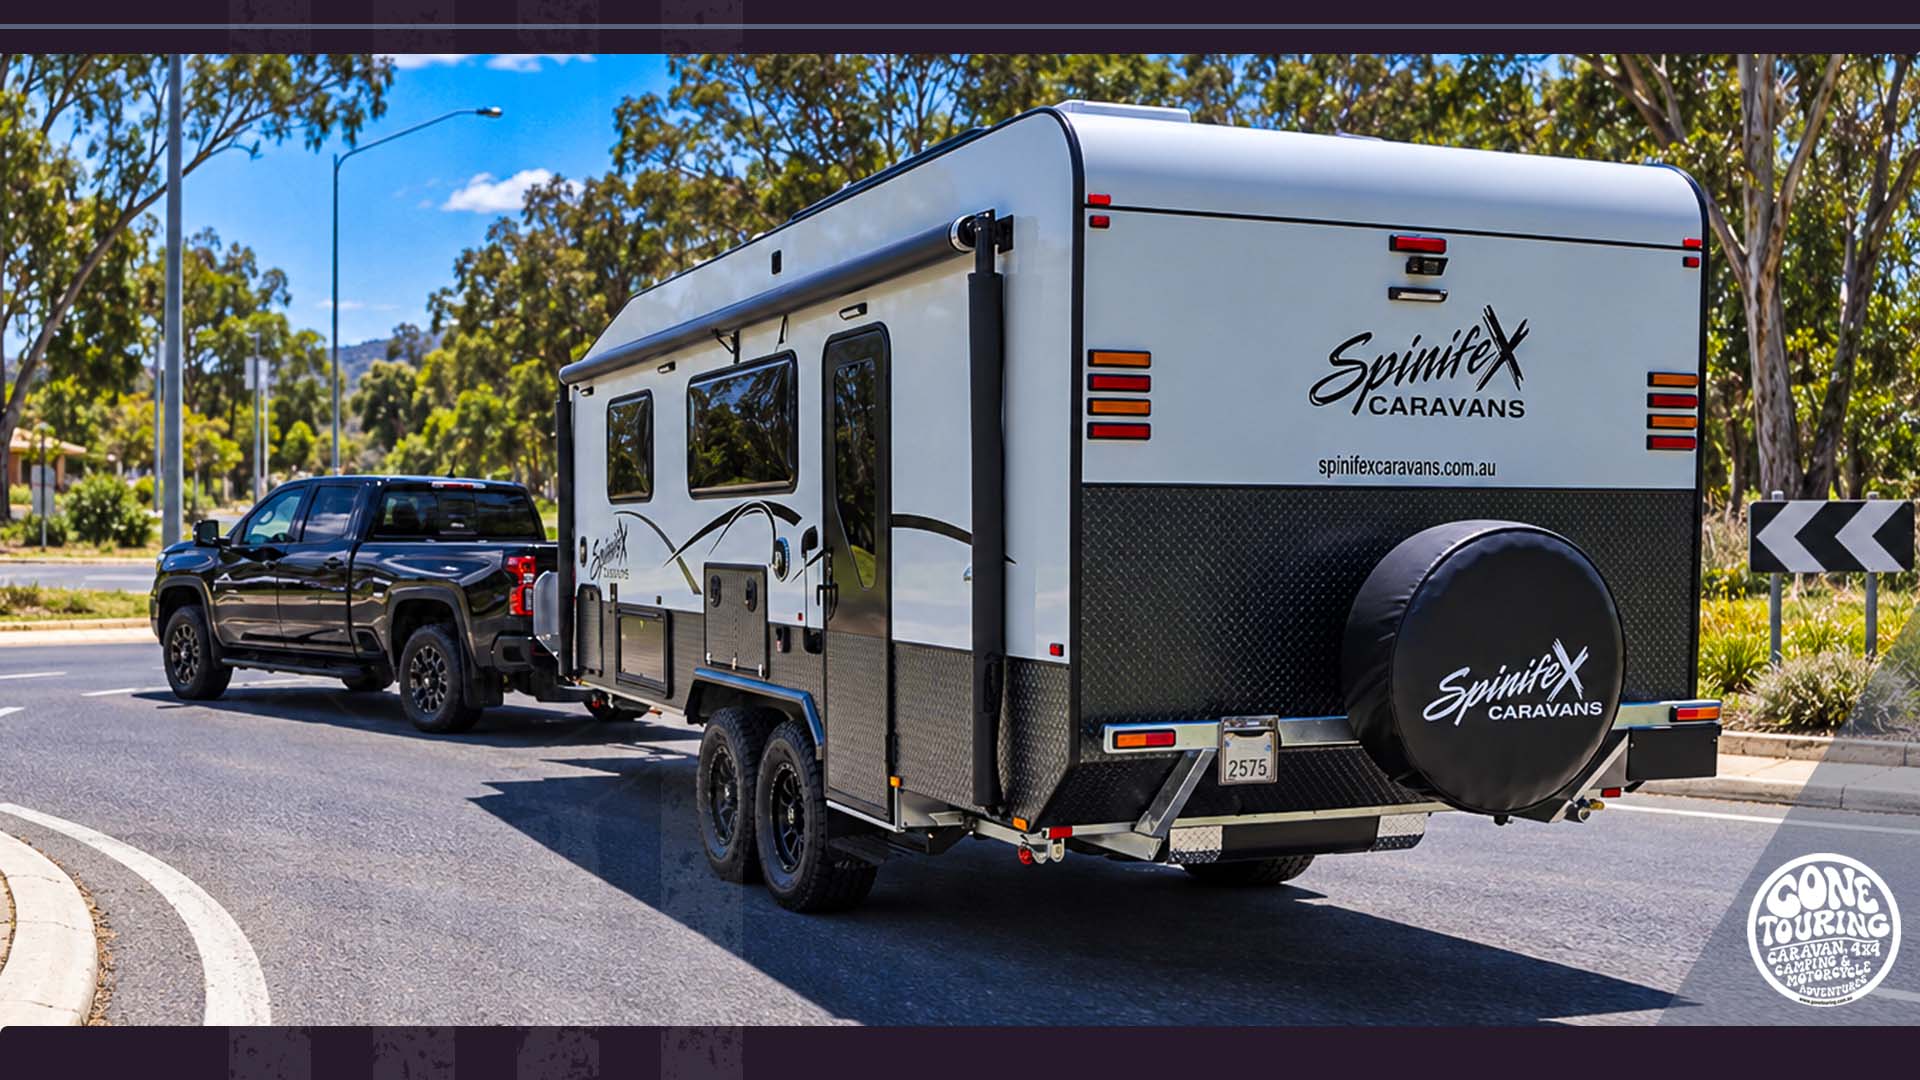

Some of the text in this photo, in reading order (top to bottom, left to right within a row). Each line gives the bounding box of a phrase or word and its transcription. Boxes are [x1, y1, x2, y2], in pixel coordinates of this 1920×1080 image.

[1368, 396, 1525, 418] CARAVANS
[1318, 456, 1496, 478] spinifexcaravans.com.au
[1488, 701, 1603, 721] CARAVANS
[1228, 758, 1268, 778] 2575
